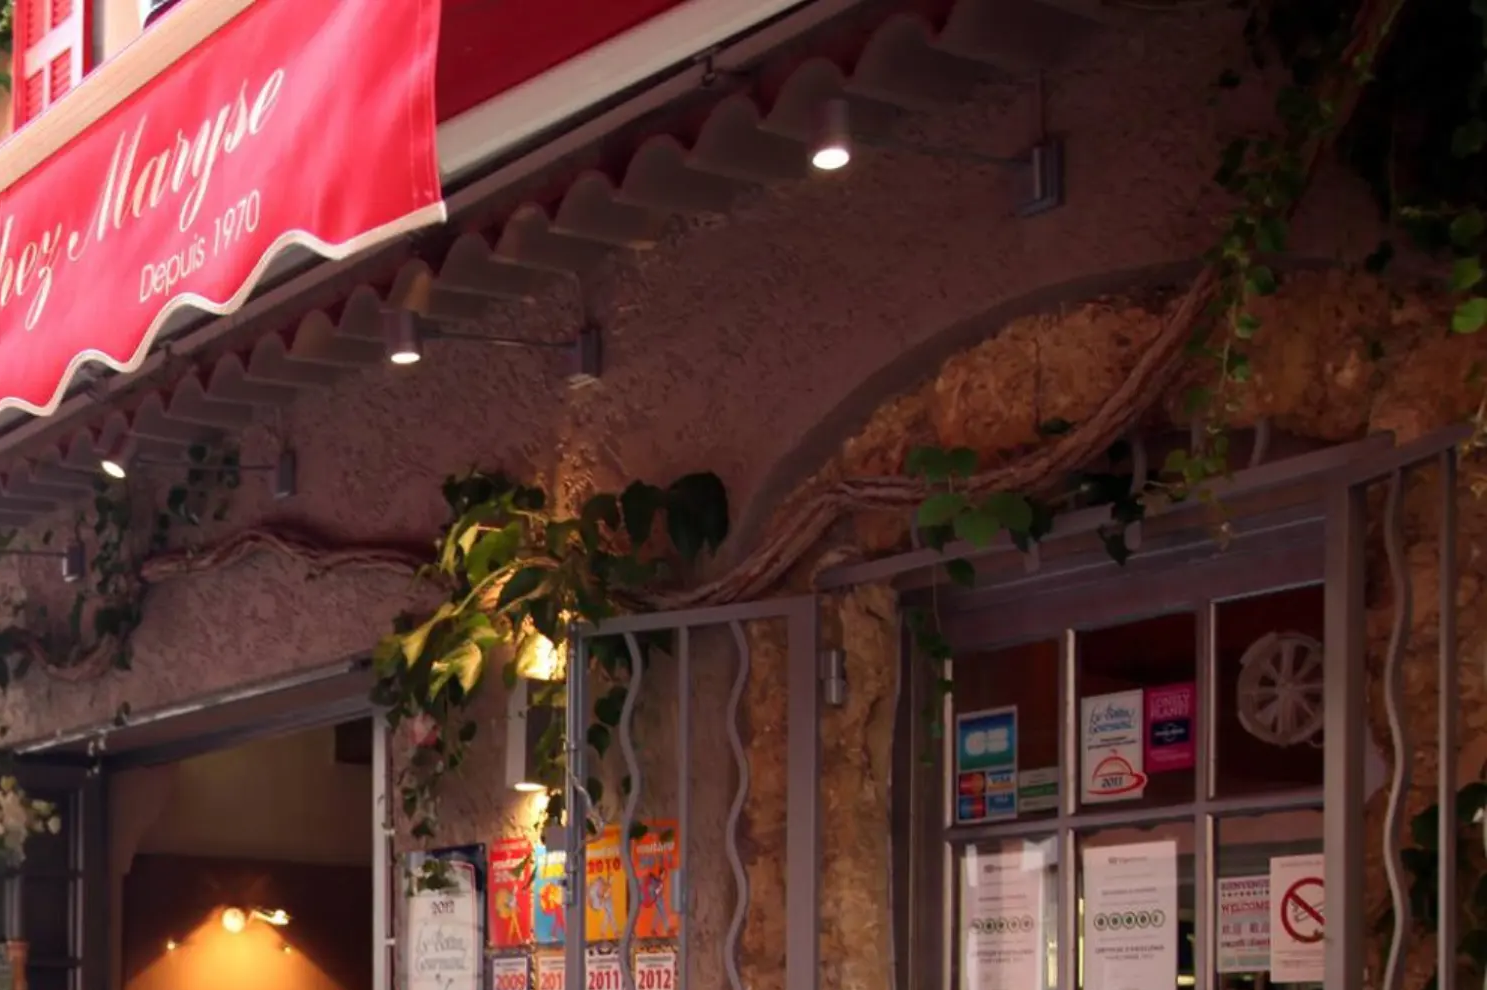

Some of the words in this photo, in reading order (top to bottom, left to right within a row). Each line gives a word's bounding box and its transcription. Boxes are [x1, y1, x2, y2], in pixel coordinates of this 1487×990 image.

[67, 67, 286, 262] Maryse
[138, 234, 207, 304] Depuis
[212, 188, 261, 257] 1970
[587, 857, 621, 874] 2010
[540, 971, 563, 990] 201
[588, 969, 620, 990] 2011
[638, 968, 672, 990] 2012
